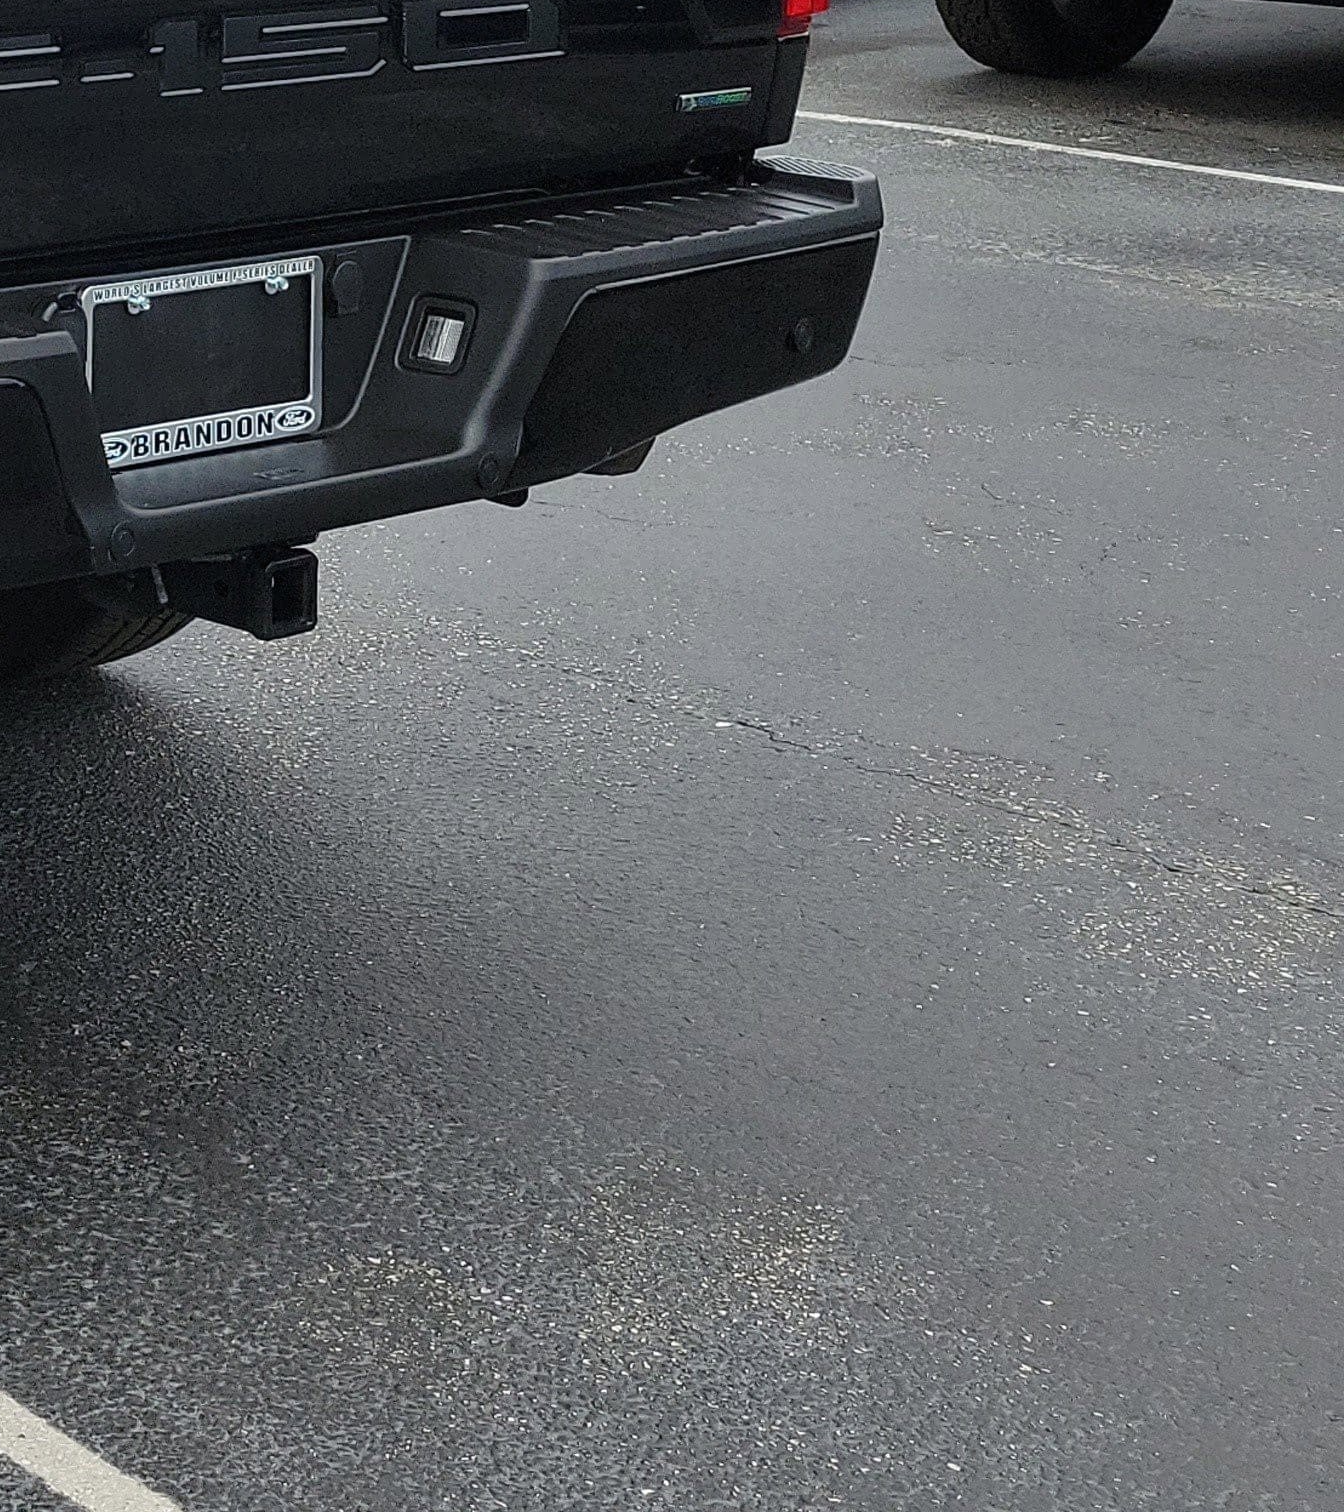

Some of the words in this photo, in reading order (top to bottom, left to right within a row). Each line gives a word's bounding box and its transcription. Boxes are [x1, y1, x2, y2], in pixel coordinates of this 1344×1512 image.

[143, 278, 187, 295] LARGEST
[190, 271, 229, 287] VOLUME
[279, 260, 314, 275] DEALER
[131, 410, 274, 459] BRANDON
[282, 410, 309, 427] Ford
